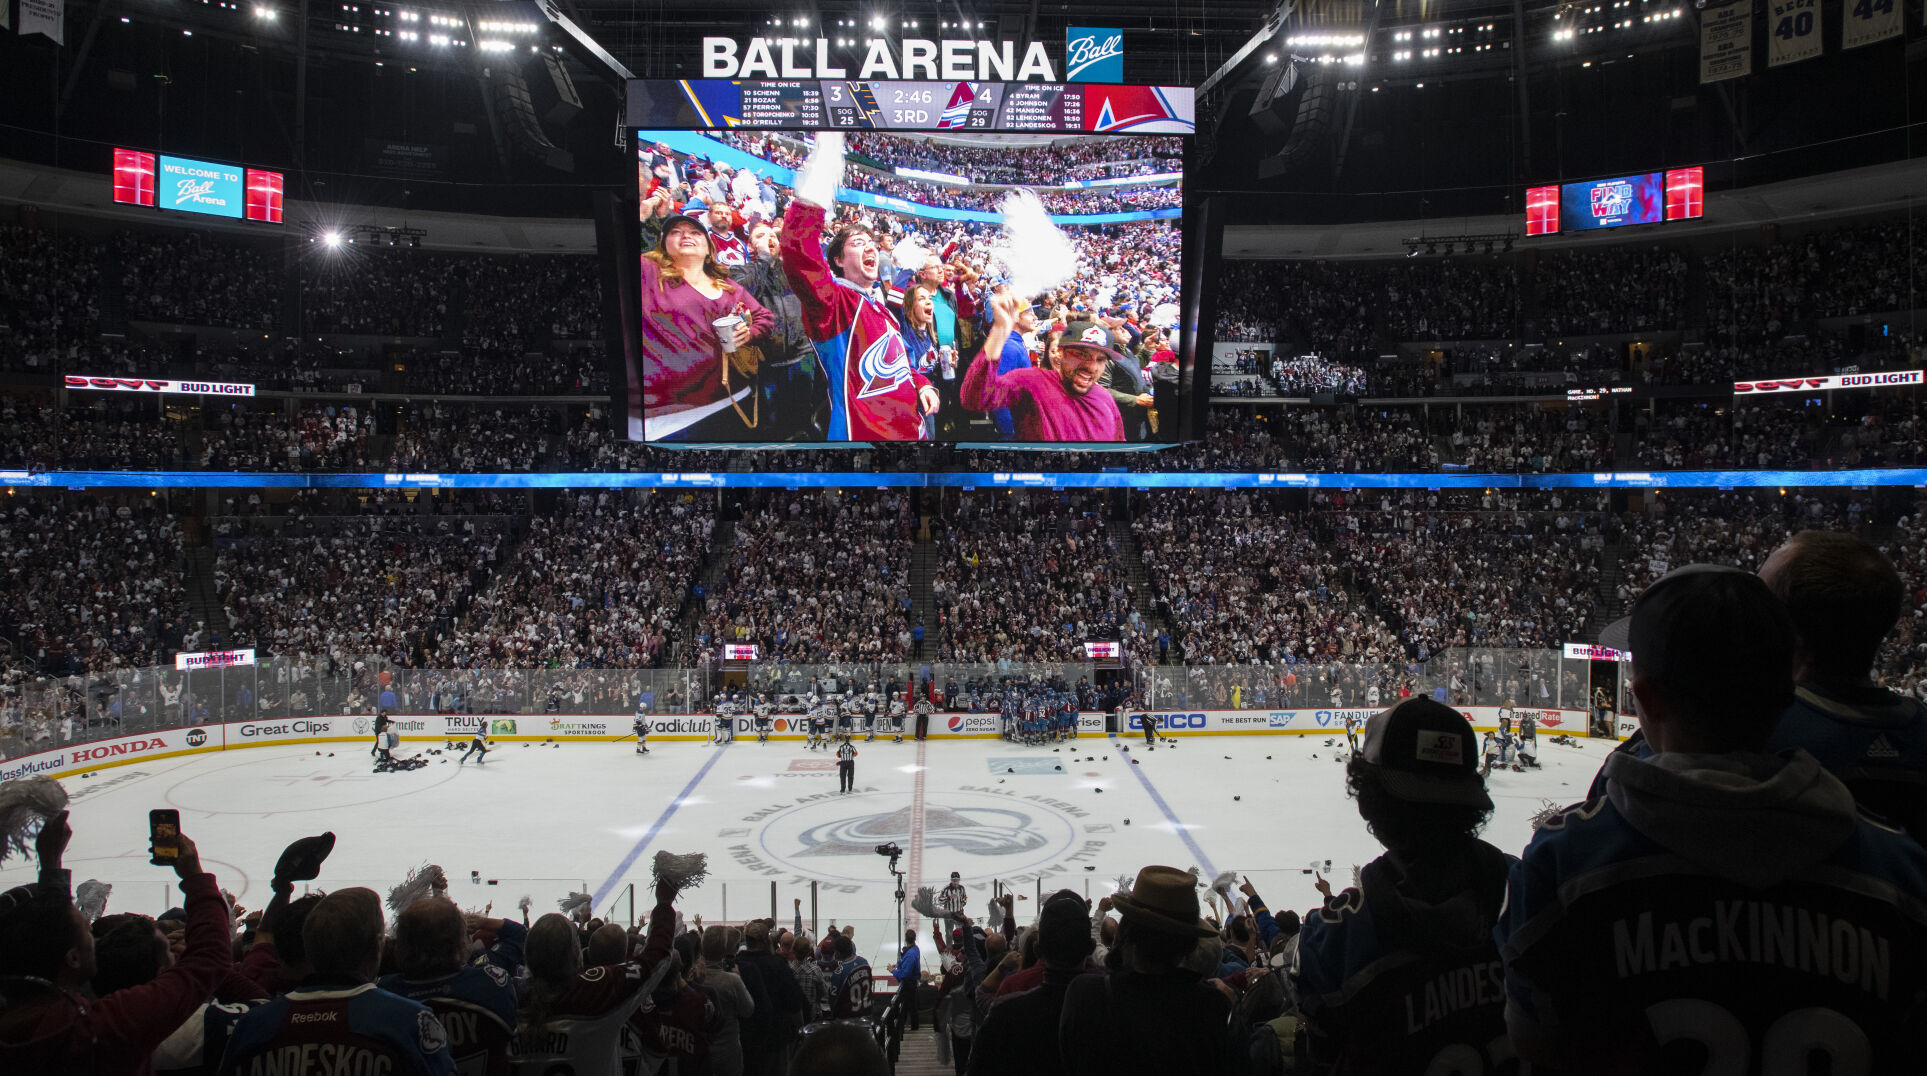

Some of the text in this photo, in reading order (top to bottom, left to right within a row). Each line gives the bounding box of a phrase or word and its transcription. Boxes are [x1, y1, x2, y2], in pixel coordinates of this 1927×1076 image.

[1775, 11, 1814, 40] 40
[702, 37, 1057, 81] BALL ARENA
[1067, 33, 1123, 75] Ball
[830, 86, 842, 102] 3
[893, 90, 933, 104] 2:46
[979, 88, 992, 104] 4
[840, 116, 855, 125] 25
[893, 109, 929, 124] 3RD
[971, 118, 986, 127] 29
[163, 164, 239, 183] WELCOME TO
[175, 178, 216, 200] Ball
[1590, 184, 1633, 203] FIND
[192, 194, 227, 206] Arena
[1591, 197, 1633, 218] WAY
[1841, 372, 1920, 387] BUD LIGHT
[181, 383, 252, 395] BUD LIGHT
[1572, 647, 1595, 656] BUD
[186, 656, 210, 666] BUD
[444, 716, 485, 727] TRULY
[965, 716, 995, 727] pepsi
[1270, 713, 1291, 723] SAP
[1542, 711, 1561, 721] Rate
[240, 721, 330, 737] Great Clips
[551, 721, 607, 731] DRAFTKINGS
[185, 733, 208, 744] TNT
[72, 737, 168, 764] HONDA
[959, 785, 1092, 818] BALL ARENA
[742, 804, 794, 822] BALL
[1064, 840, 1107, 862] BALL
[727, 843, 787, 876] ARENA
[850, 979, 872, 1012] 92
[291, 1011, 338, 1024] Reebok
